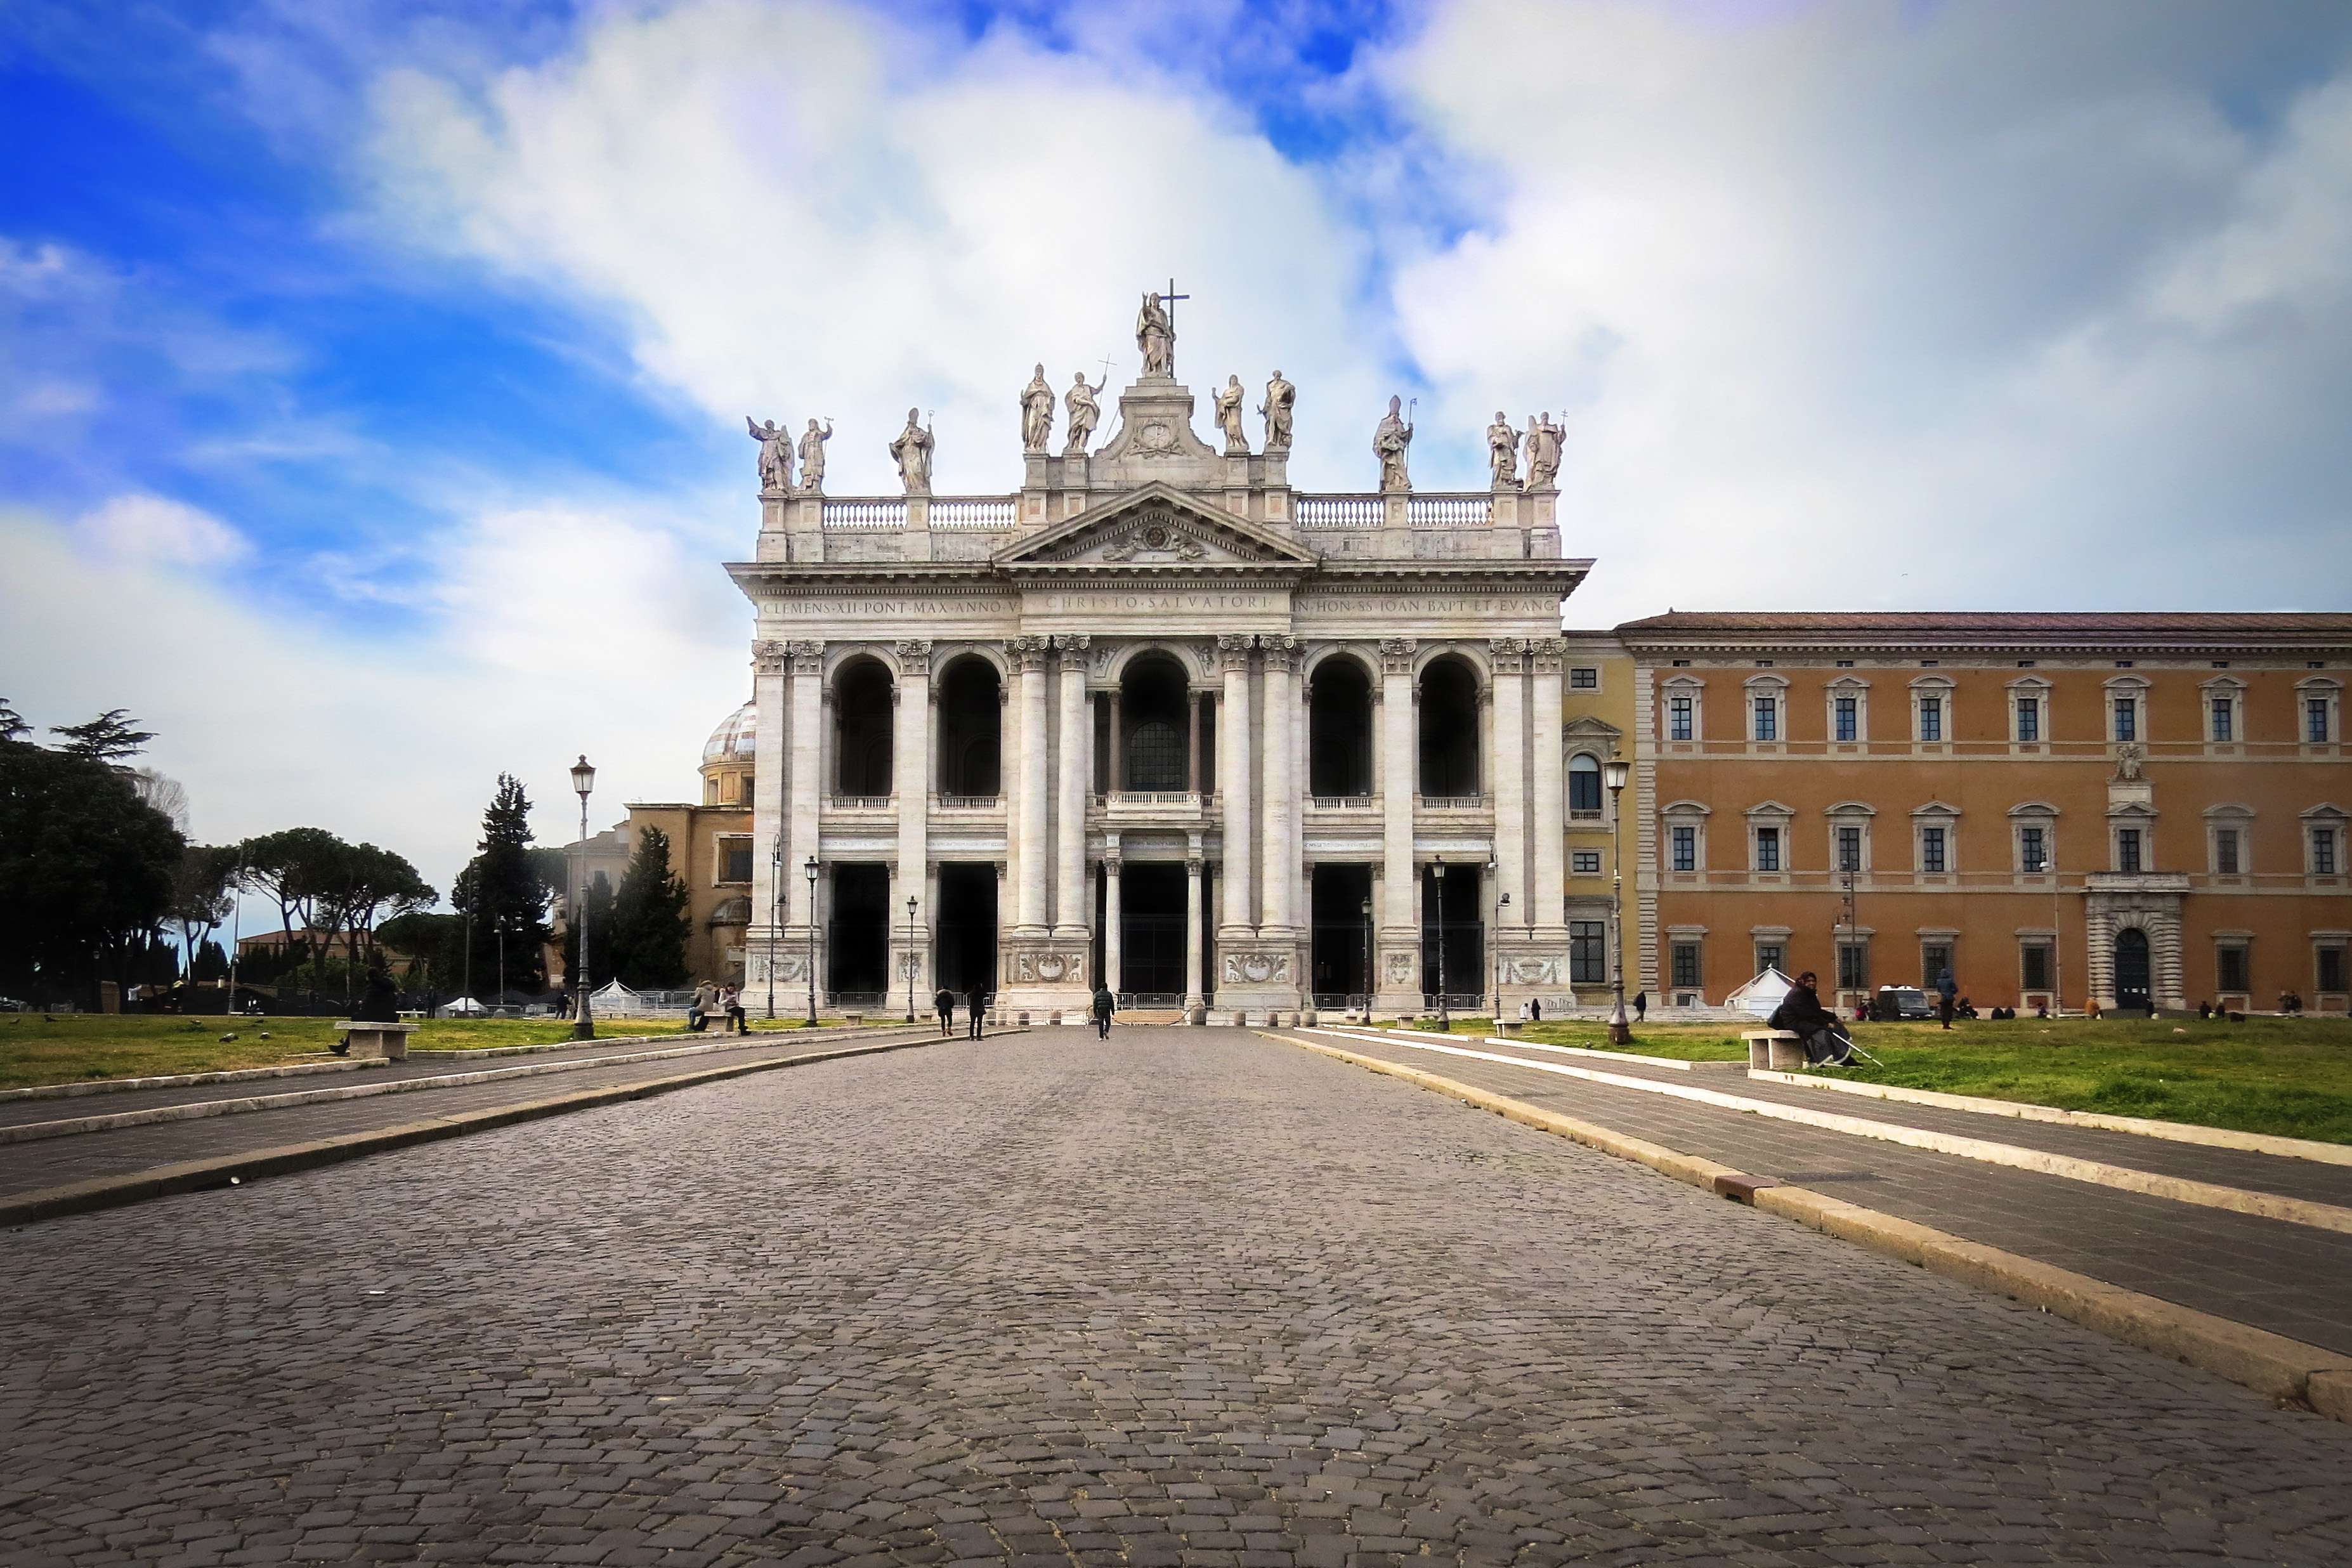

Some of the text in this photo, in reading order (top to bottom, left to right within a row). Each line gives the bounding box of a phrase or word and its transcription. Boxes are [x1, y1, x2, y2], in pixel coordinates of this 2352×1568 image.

[764, 602, 830, 614] CLEMENS
[837, 602, 856, 614] XII
[864, 602, 906, 613] PONT
[913, 601, 948, 613] MAX
[955, 601, 1001, 613] ANNO
[1046, 596, 1267, 608] CHRISTO SALVATORI
[1292, 600, 1308, 613] IN
[1316, 601, 1350, 613] HON
[1380, 600, 1420, 612] IOAN
[1427, 600, 1466, 612] BAPT
[1474, 600, 1491, 611] ET
[1499, 599, 1554, 611] EVANG
